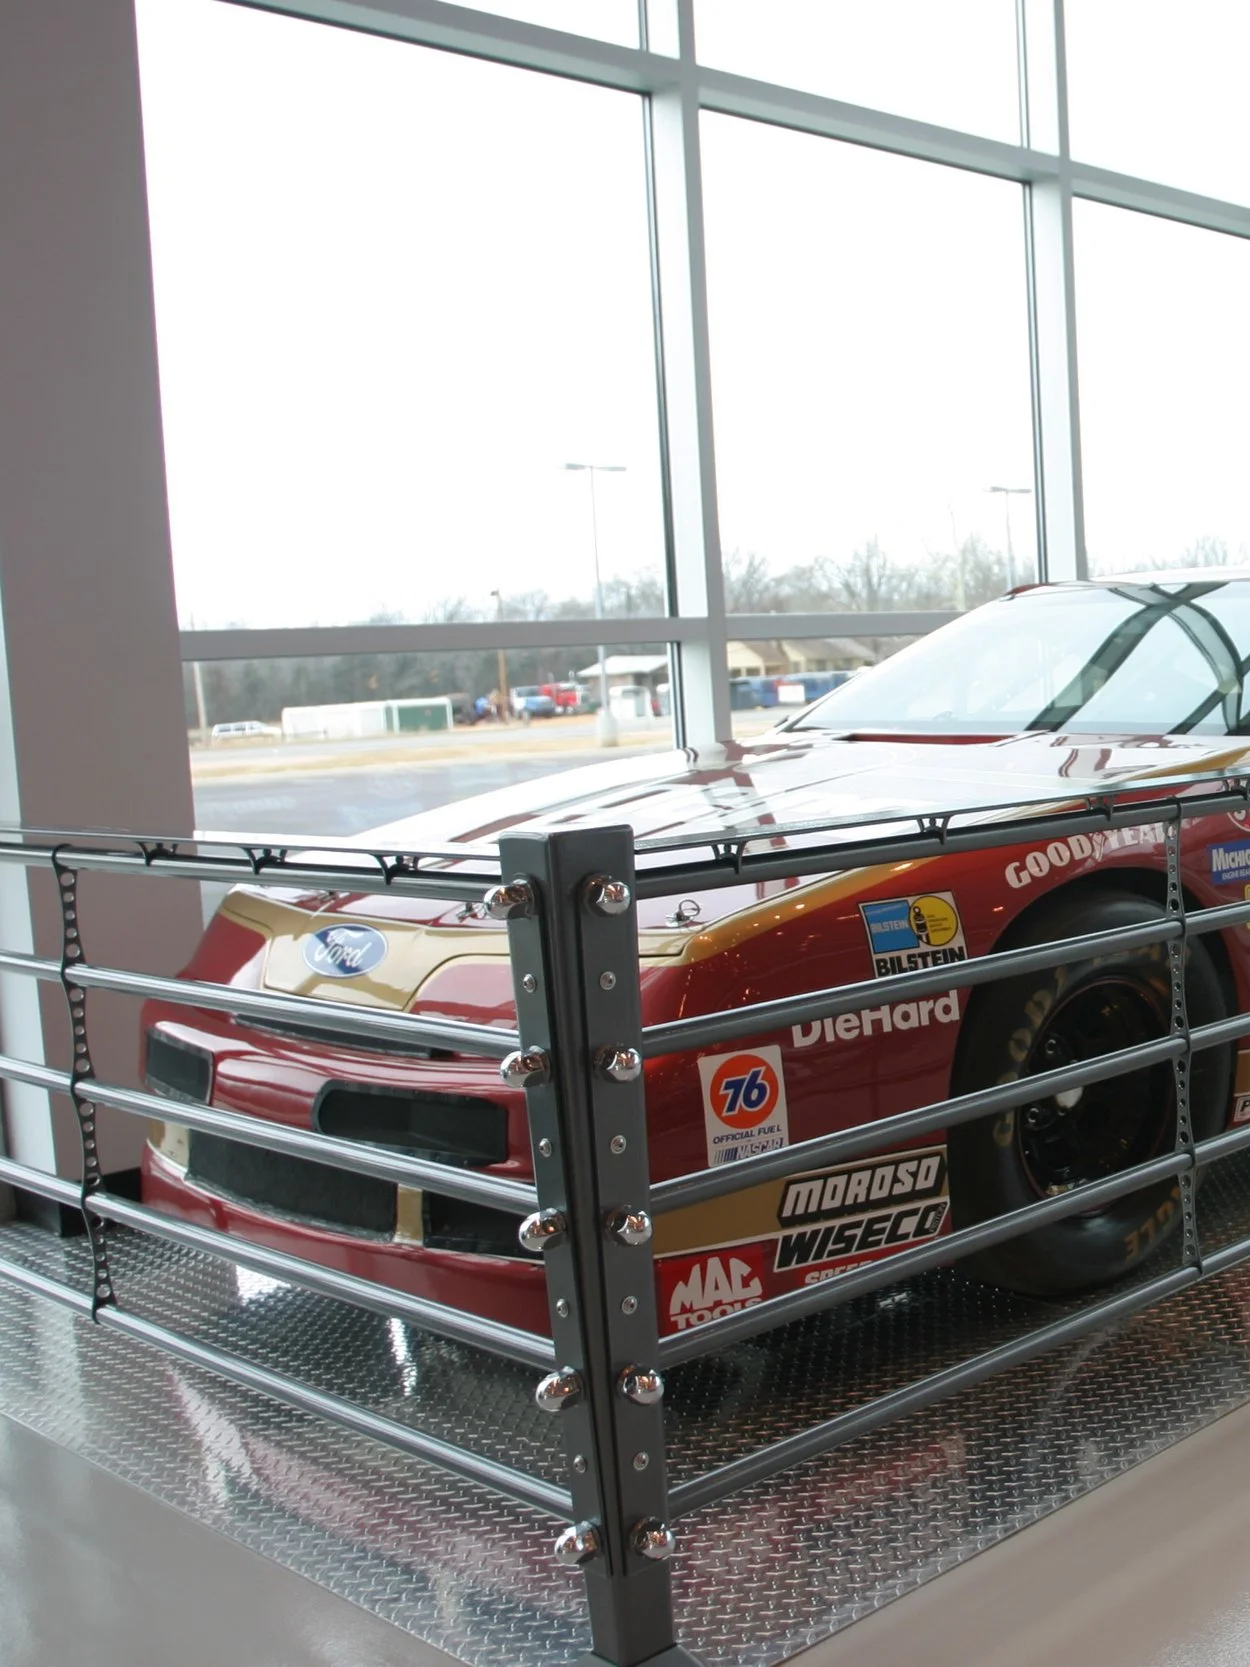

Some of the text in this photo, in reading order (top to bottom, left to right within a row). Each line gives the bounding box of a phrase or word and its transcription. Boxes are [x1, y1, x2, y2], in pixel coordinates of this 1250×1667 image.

[314, 927, 373, 968] Ford
[874, 945, 966, 977] BILSTEIN
[791, 989, 960, 1048] DieHard
[720, 1066, 771, 1117] 76
[713, 1124, 783, 1144] OFFICIAL FUEL
[736, 1137, 784, 1160] NASCAR
[780, 1155, 940, 1219] MOROSO
[777, 1202, 947, 1268] WISECO
[669, 1256, 763, 1315] MAC
